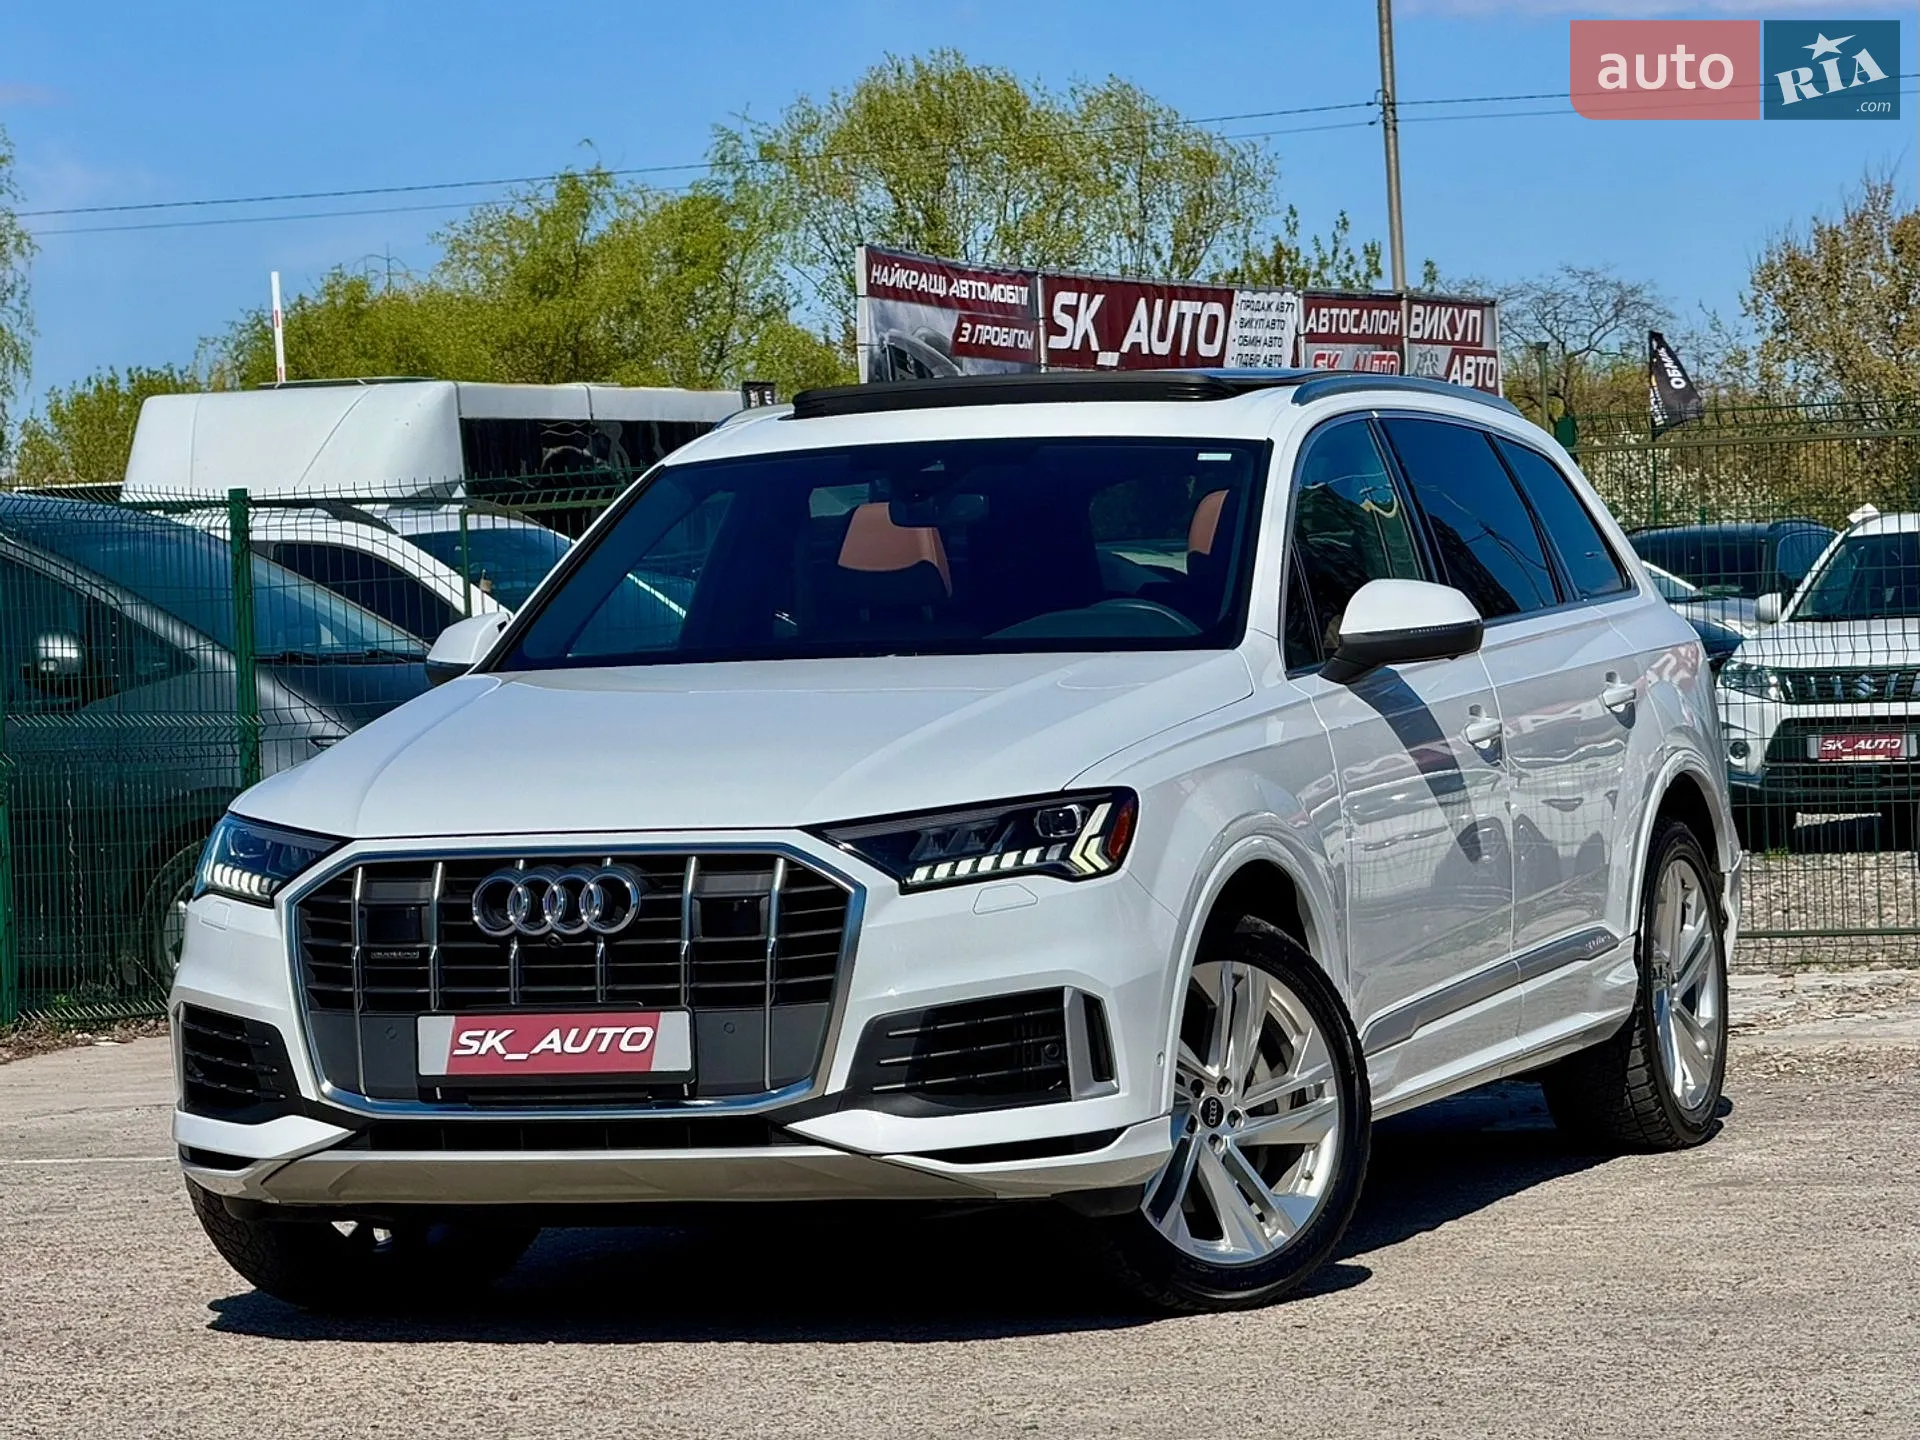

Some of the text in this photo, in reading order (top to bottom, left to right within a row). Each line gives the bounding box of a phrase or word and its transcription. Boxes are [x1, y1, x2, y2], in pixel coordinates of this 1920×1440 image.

[870, 262, 946, 297] НАЙКРАЩІ
[1239, 299, 1274, 312] ПРОДАЖ
[958, 322, 971, 342] З
[1047, 291, 1225, 367] SK_AUTO
[1239, 317, 1286, 331] ВИКУП АВТО
[1305, 307, 1400, 336] АВТОСАЛОН
[1408, 304, 1481, 343] ВИКУП
[1237, 335, 1284, 348] ОБМІН АВТО
[1262, 354, 1283, 368] АВТО
[1449, 354, 1497, 388] АВТО
[1821, 738, 1902, 752] SK_AUTO
[452, 1026, 654, 1060] SK_AUTO
